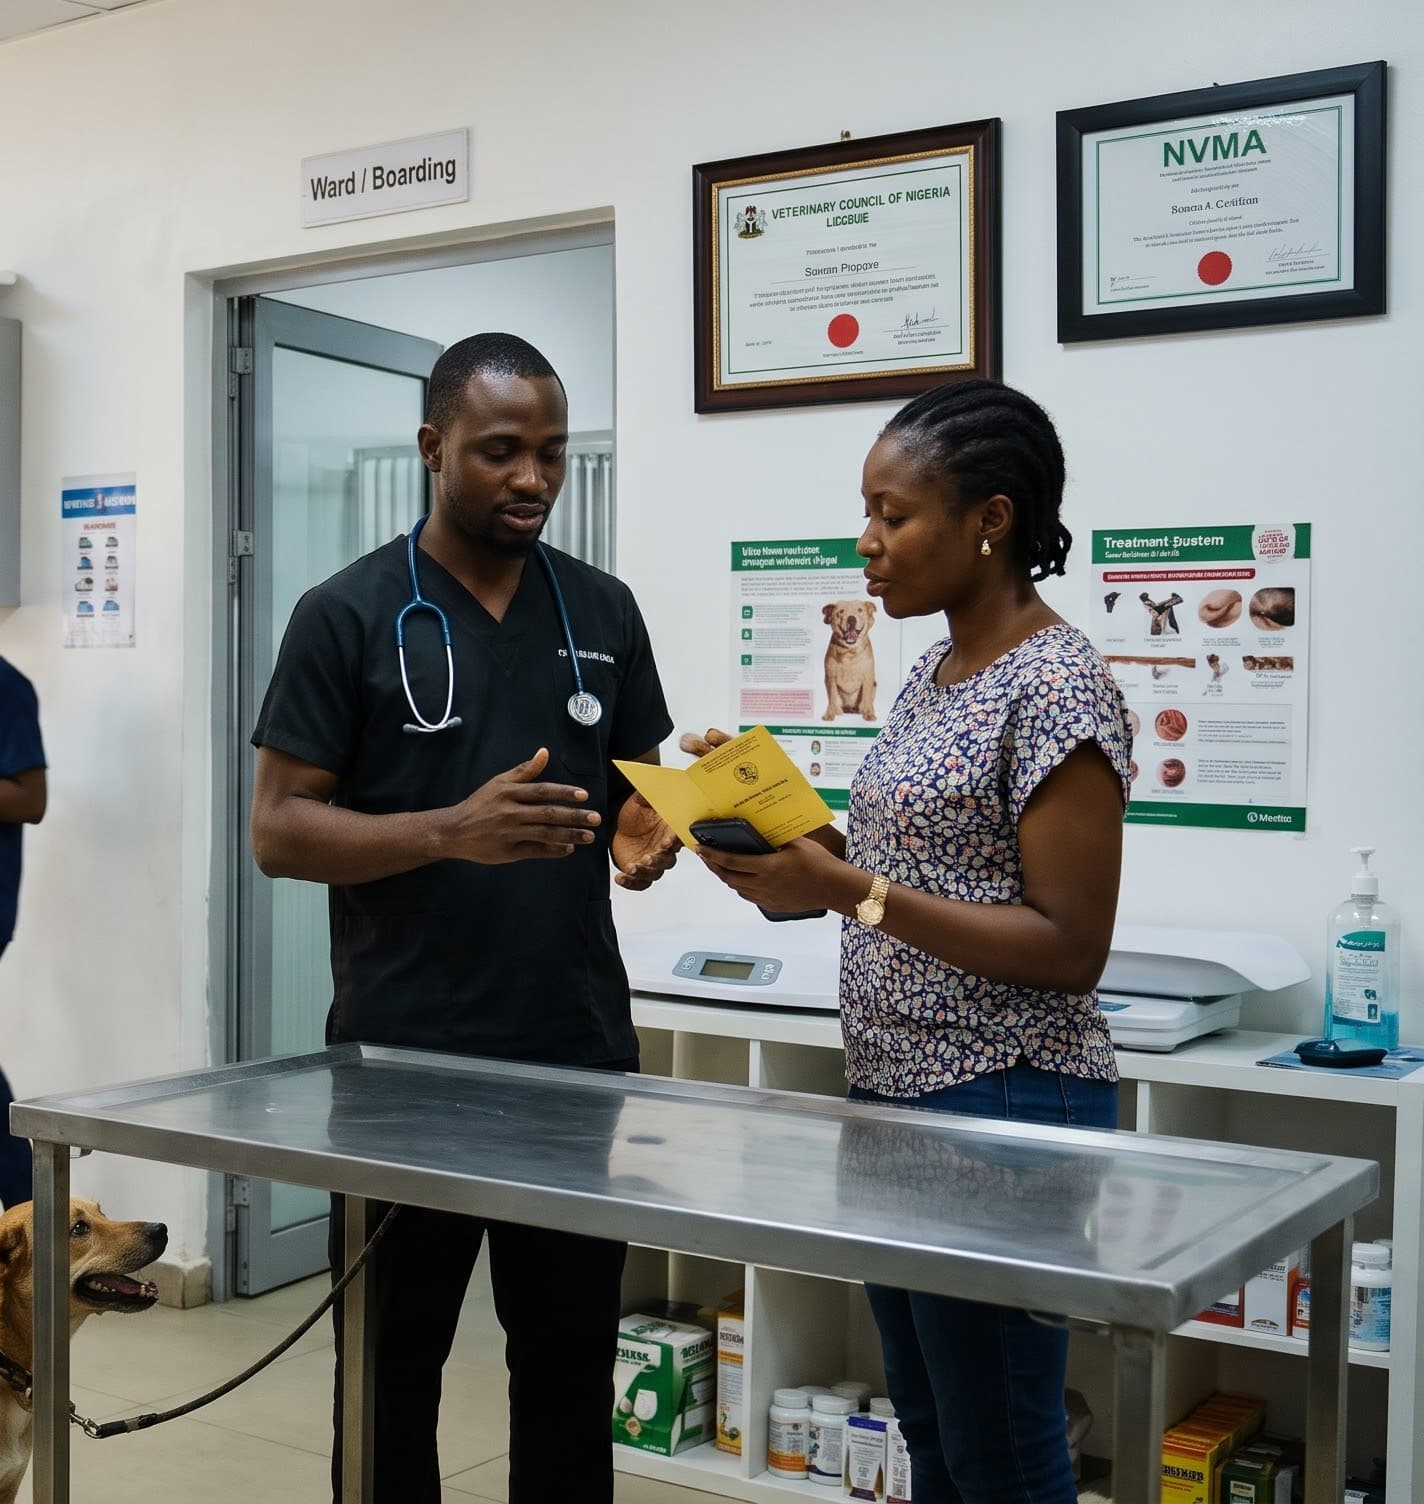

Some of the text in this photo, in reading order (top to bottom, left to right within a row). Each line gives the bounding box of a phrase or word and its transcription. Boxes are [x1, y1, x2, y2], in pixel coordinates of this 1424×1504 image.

[1163, 129, 1267, 168] NVMA
[310, 157, 456, 201] Ward / Boarding
[772, 186, 951, 220] VETERINARY COUNCIL OF NIGERIA
